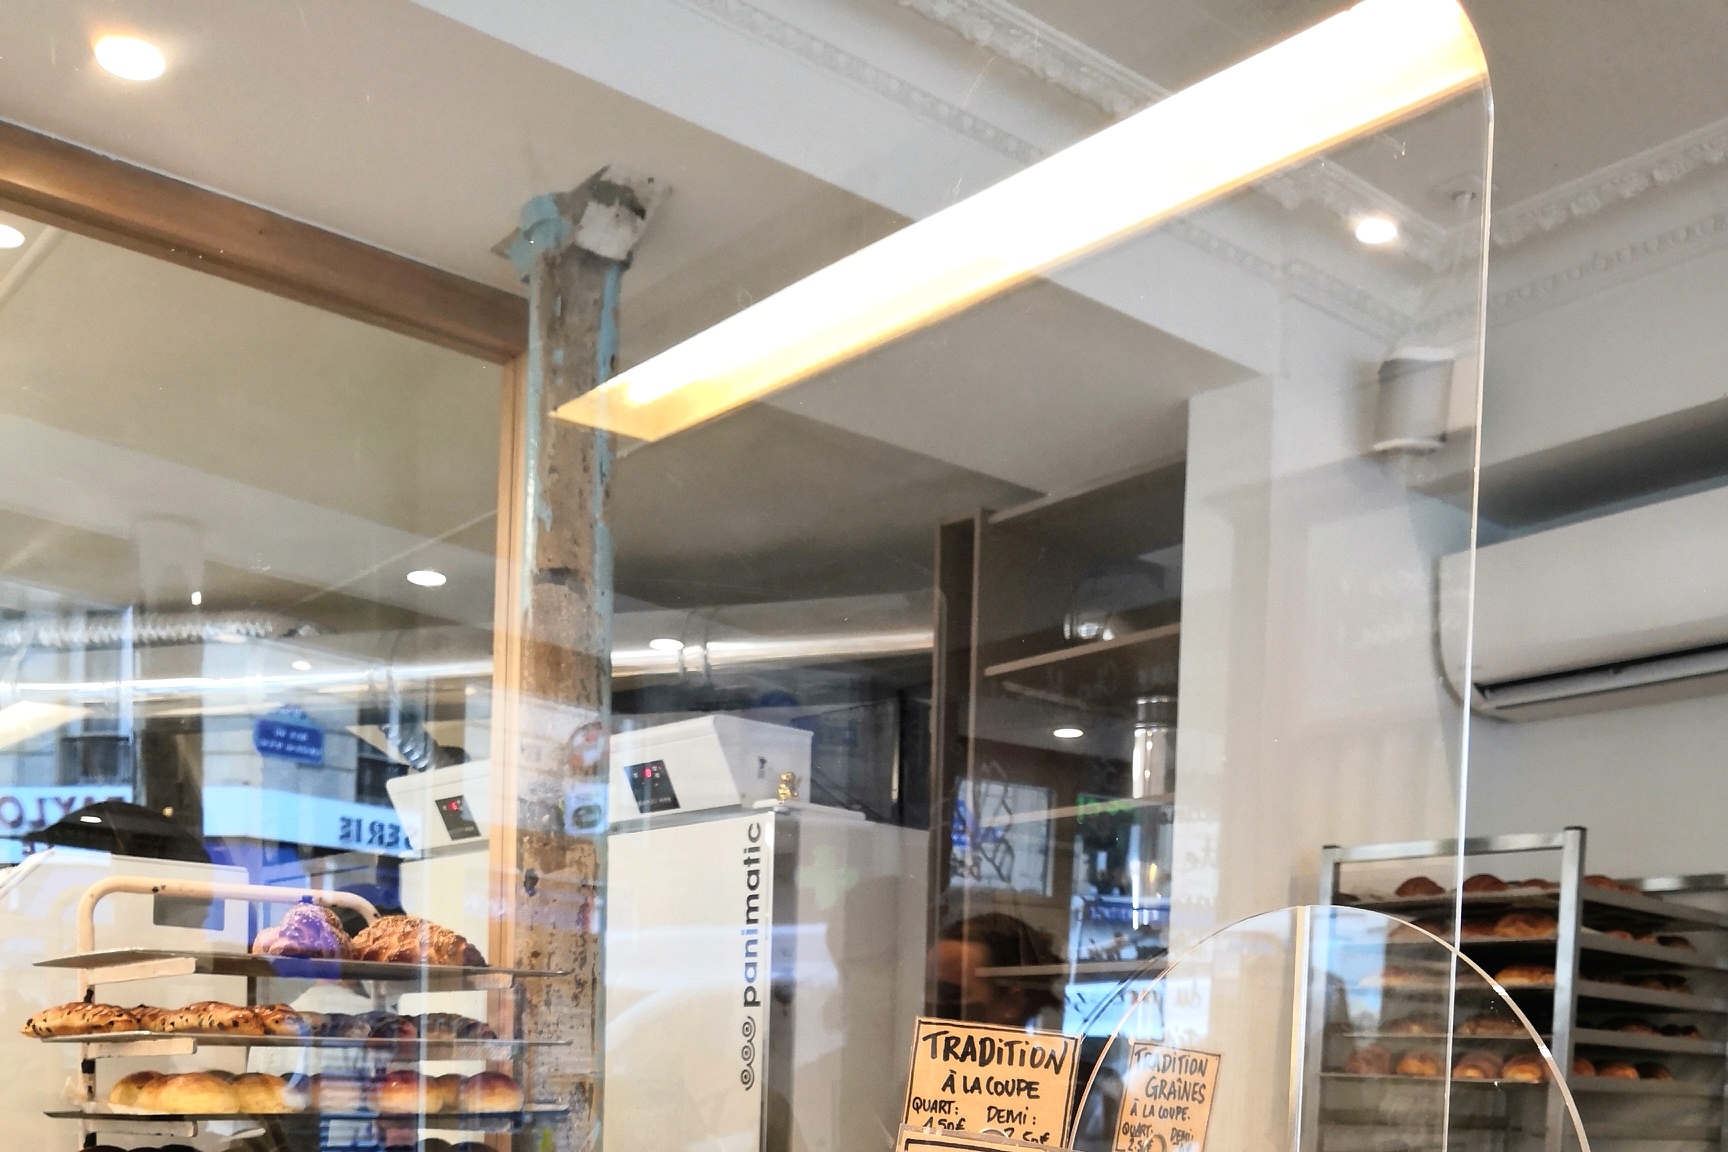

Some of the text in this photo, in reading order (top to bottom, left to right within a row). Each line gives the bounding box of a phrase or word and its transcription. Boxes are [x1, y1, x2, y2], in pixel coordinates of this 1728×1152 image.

[741, 822, 762, 1008] panimatic
[922, 1030, 1069, 1075] TRADiTiON
[941, 1069, 1040, 1100] À LA COUPE
[1145, 1075, 1207, 1104] GRAÎNES
[912, 1097, 959, 1115] QUART:
[1142, 1103, 1155, 1119] LA
